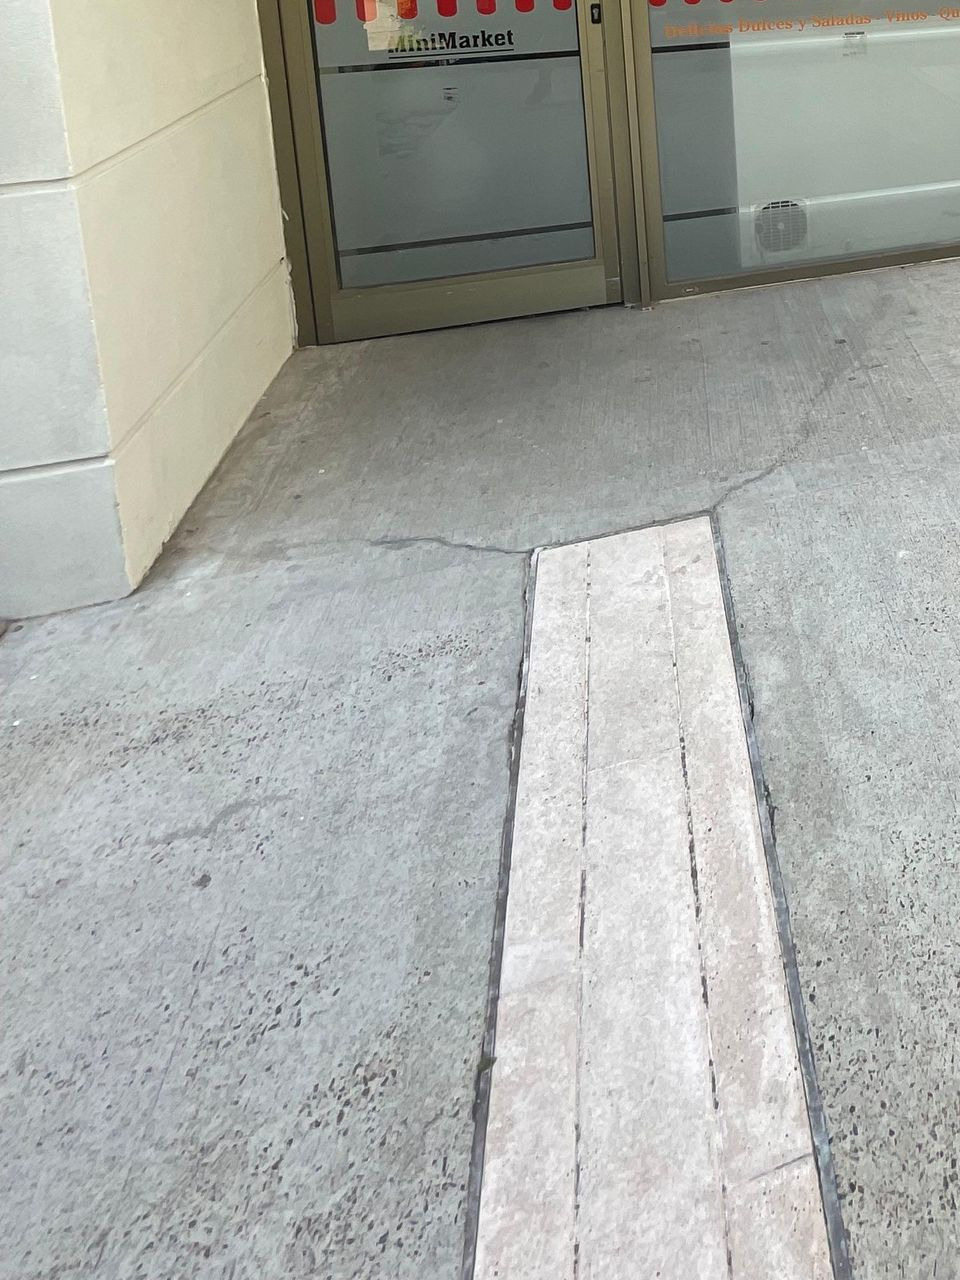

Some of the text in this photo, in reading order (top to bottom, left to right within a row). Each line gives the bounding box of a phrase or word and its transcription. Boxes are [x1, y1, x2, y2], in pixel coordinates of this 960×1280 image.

[739, 16, 793, 33] Dulces
[798, 18, 807, 31] y
[885, 10, 928, 23] Vinos
[388, 29, 514, 53] MiniMarket
